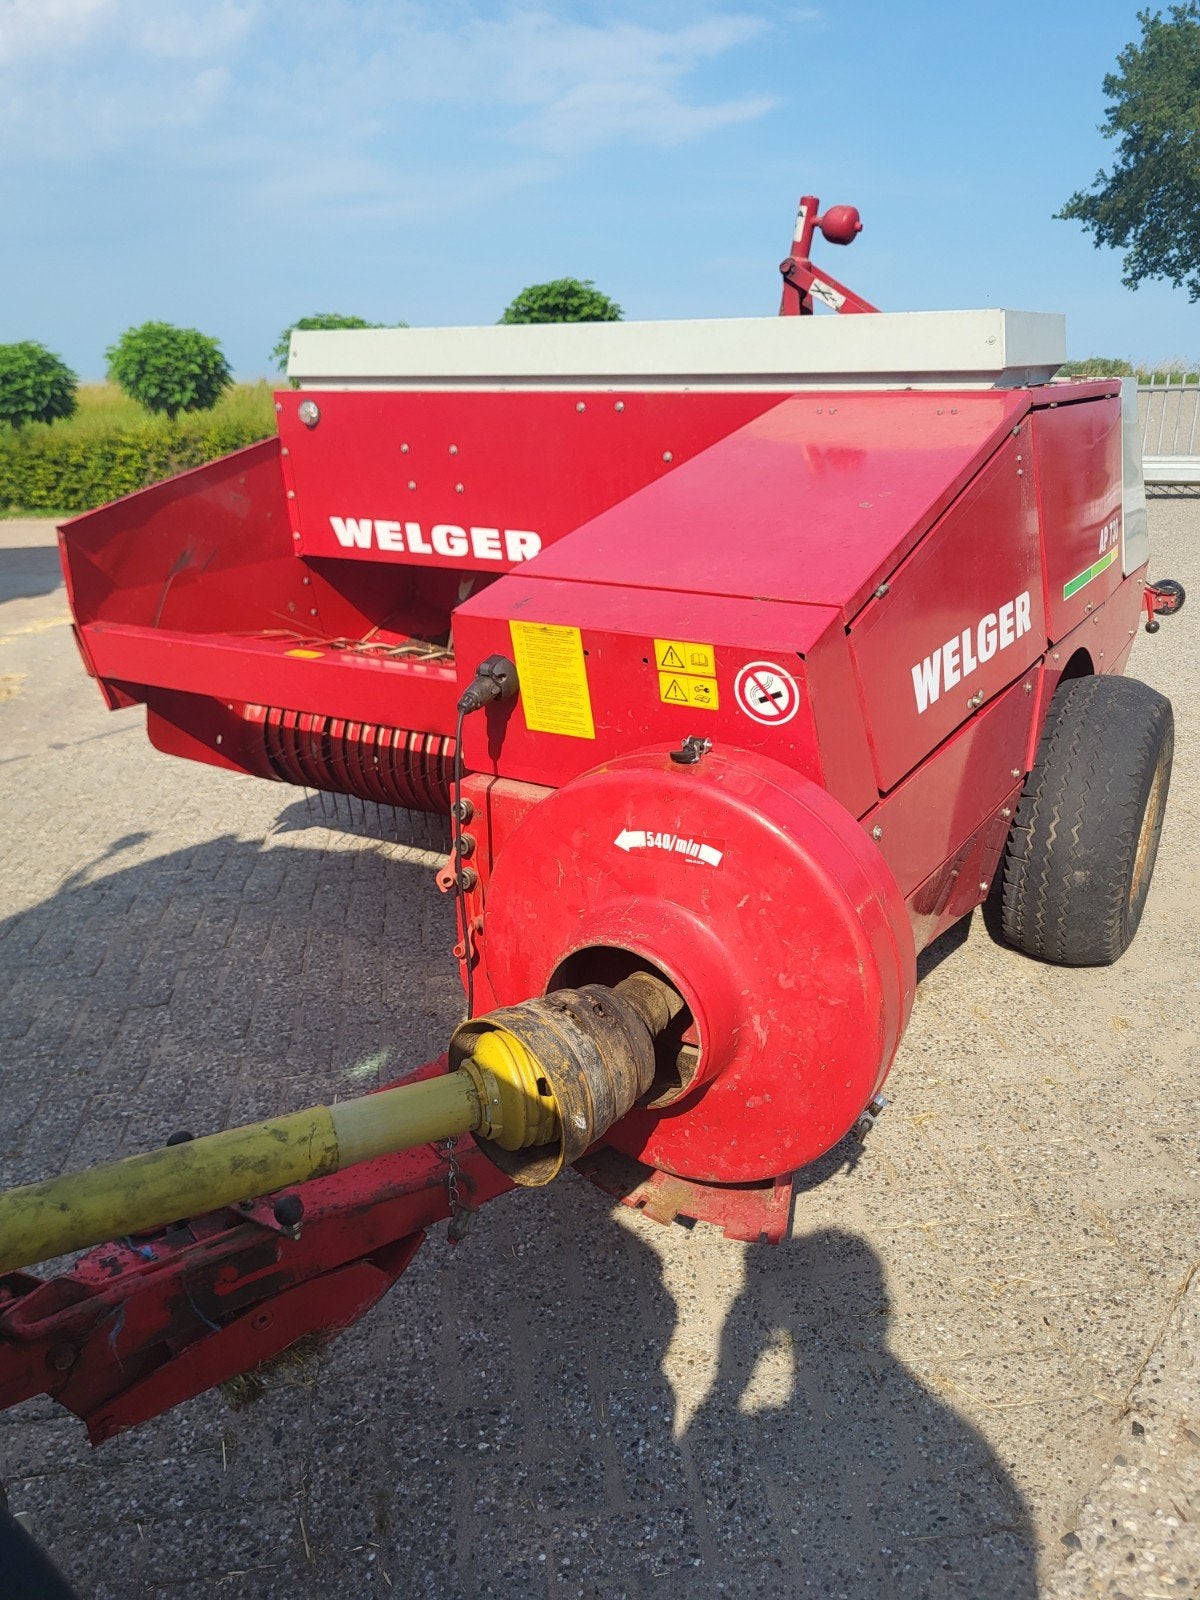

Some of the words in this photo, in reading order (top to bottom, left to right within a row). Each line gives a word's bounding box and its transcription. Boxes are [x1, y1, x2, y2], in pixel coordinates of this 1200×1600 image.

[329, 516, 541, 562] WELGER
[1099, 525, 1109, 554] AP
[911, 591, 1031, 714] WELGER
[646, 831, 701, 858] 540/min
